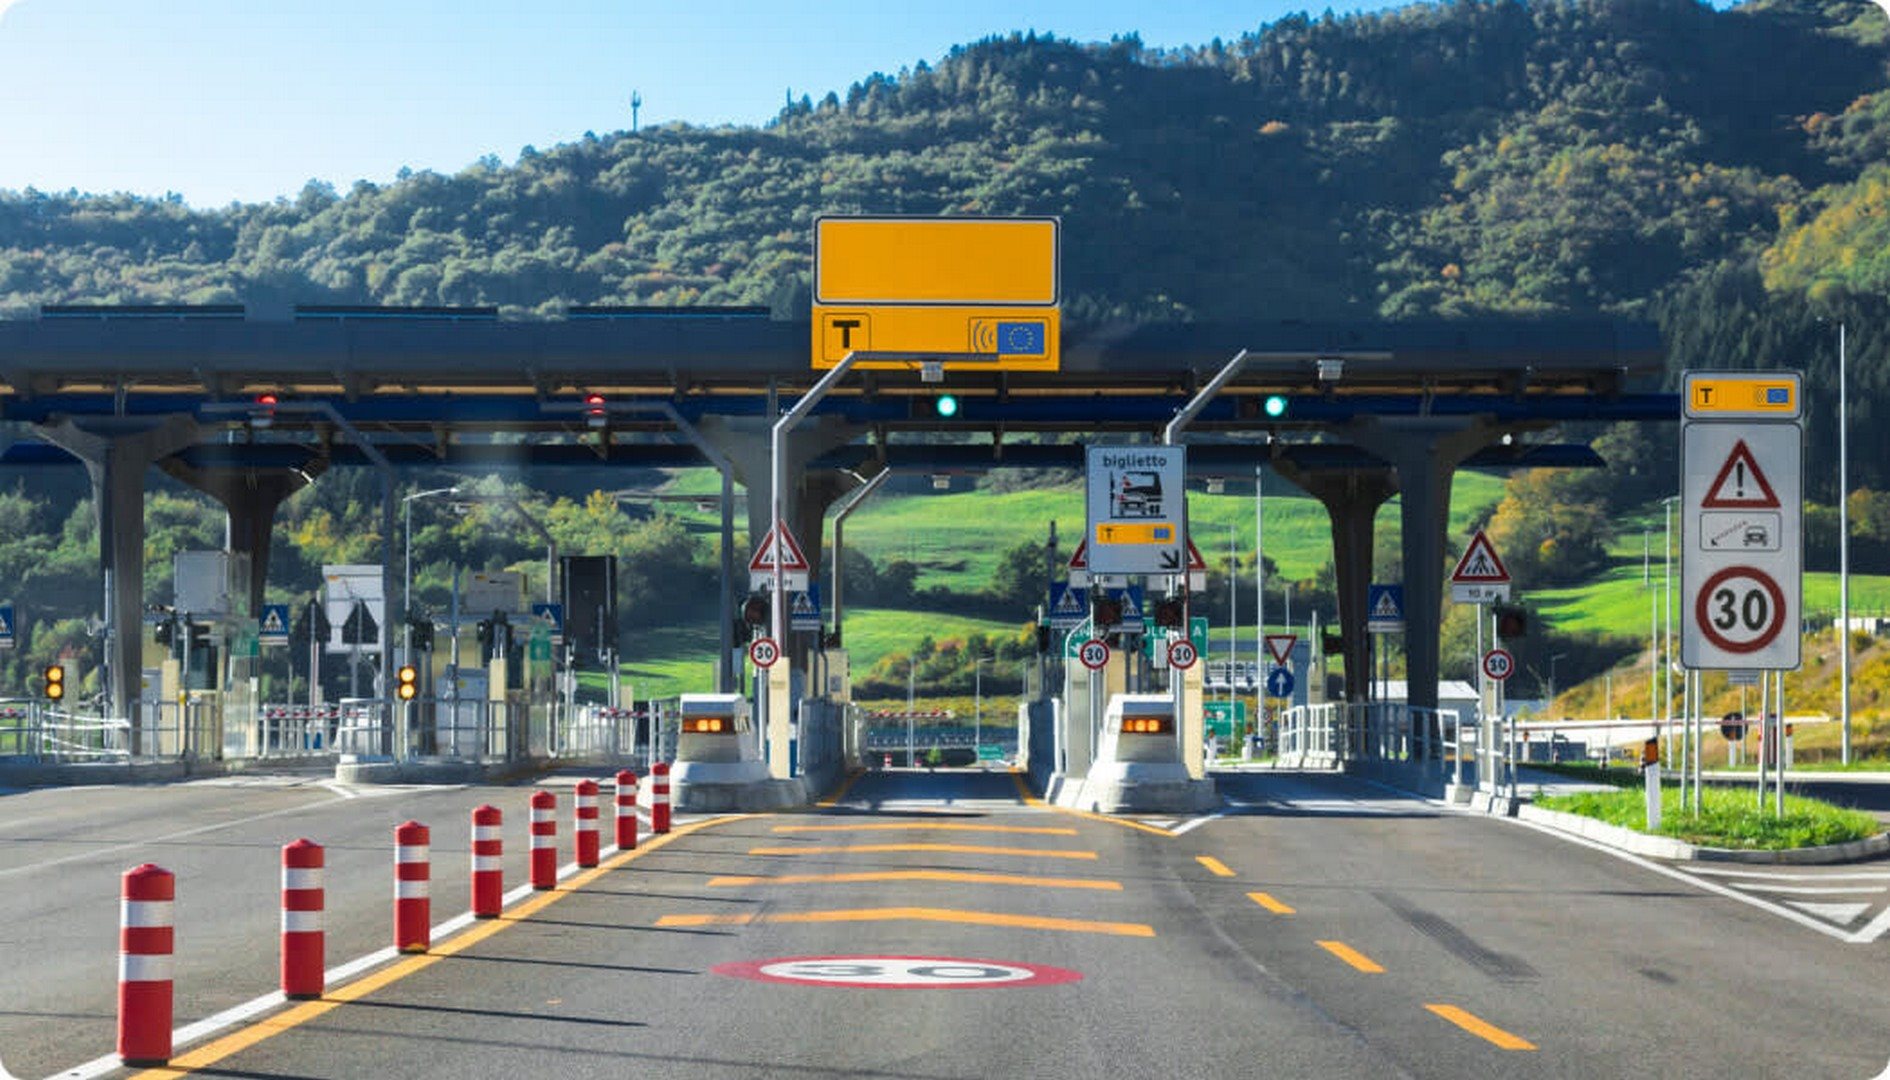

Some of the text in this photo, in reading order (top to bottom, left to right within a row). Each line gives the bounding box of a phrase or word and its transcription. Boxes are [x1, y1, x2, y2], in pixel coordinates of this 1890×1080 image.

[832, 320, 860, 348] T
[1700, 387, 1713, 403] T
[1103, 455, 1167, 469] biglietto
[1714, 588, 1767, 631] 30
[756, 647, 773, 660] 30
[1086, 649, 1104, 661] 30
[1174, 648, 1192, 660] 30
[1490, 658, 1507, 672] 30
[791, 964, 1011, 979] 30
